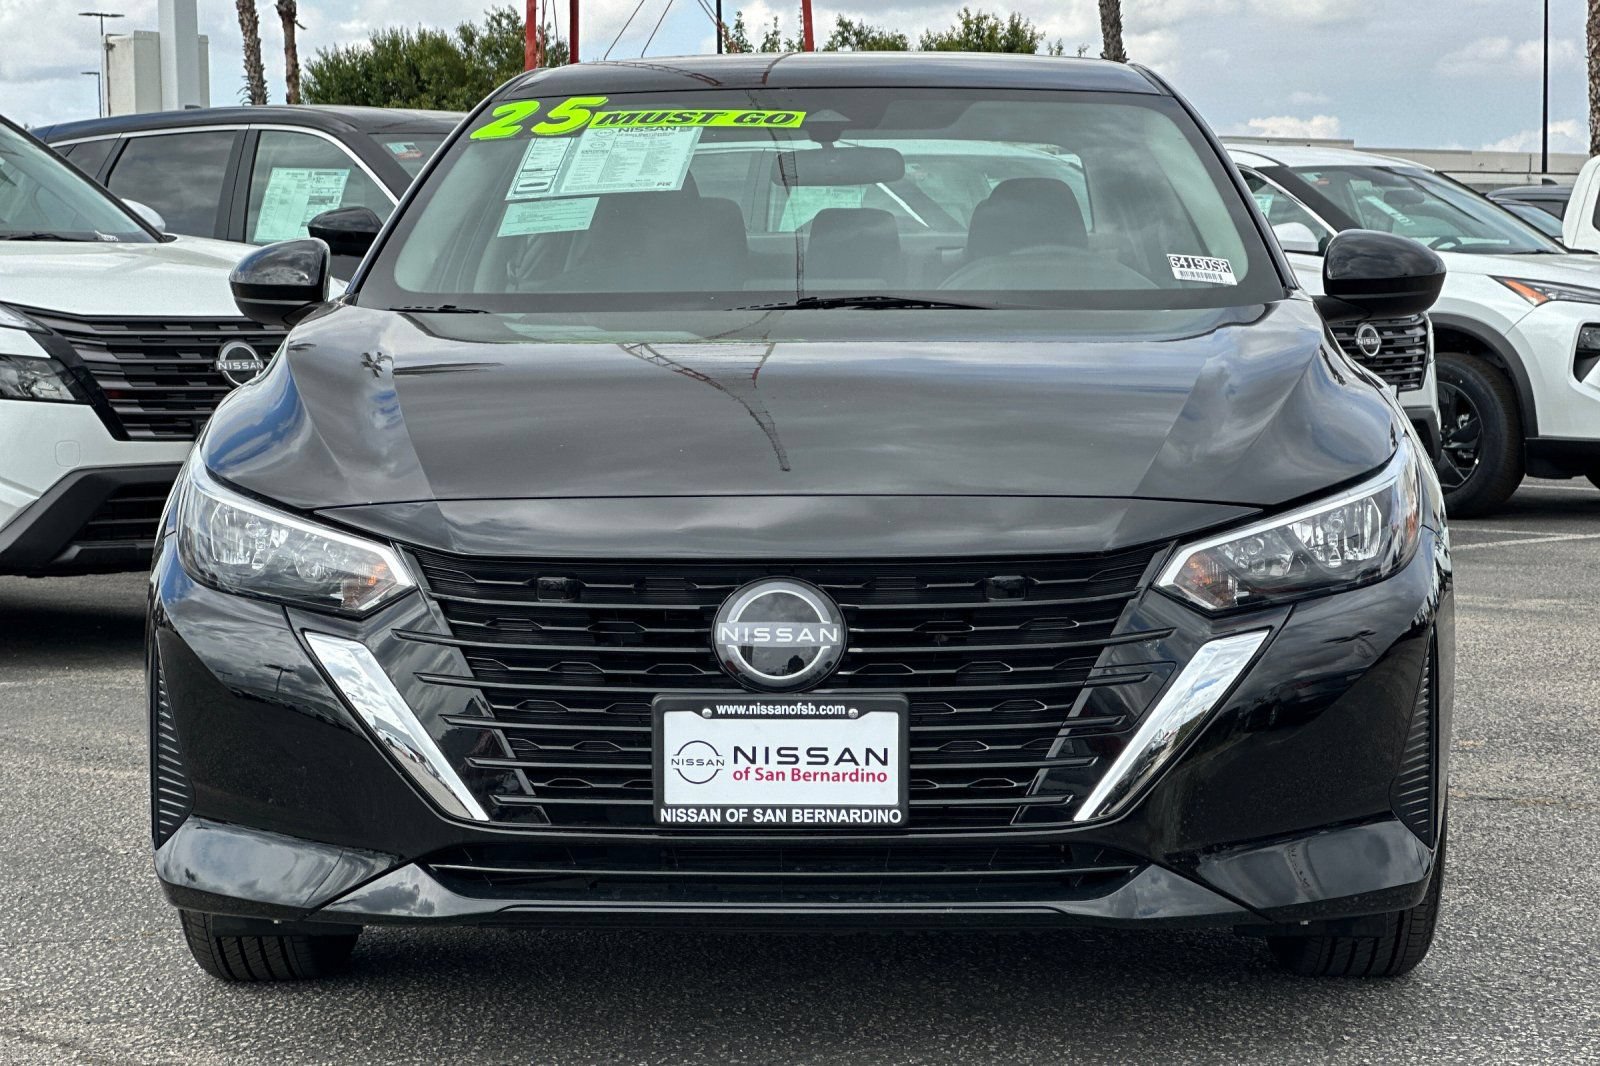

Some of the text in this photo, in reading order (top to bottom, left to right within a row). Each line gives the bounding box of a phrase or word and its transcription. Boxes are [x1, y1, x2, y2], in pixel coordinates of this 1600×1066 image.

[470, 96, 608, 141] 25
[595, 111, 730, 126] MUST
[732, 111, 799, 126] GO
[1168, 256, 1233, 274] 64190SR
[218, 361, 264, 370] NISSAN
[721, 626, 838, 643] NISSAN
[716, 702, 846, 715] www.nissanofsb.com
[671, 758, 725, 767] NISSAN
[733, 745, 889, 766] NISSAN
[733, 766, 888, 783] of San Bernardino
[660, 808, 902, 824] NISSAN OF SAN BERNARDINO
